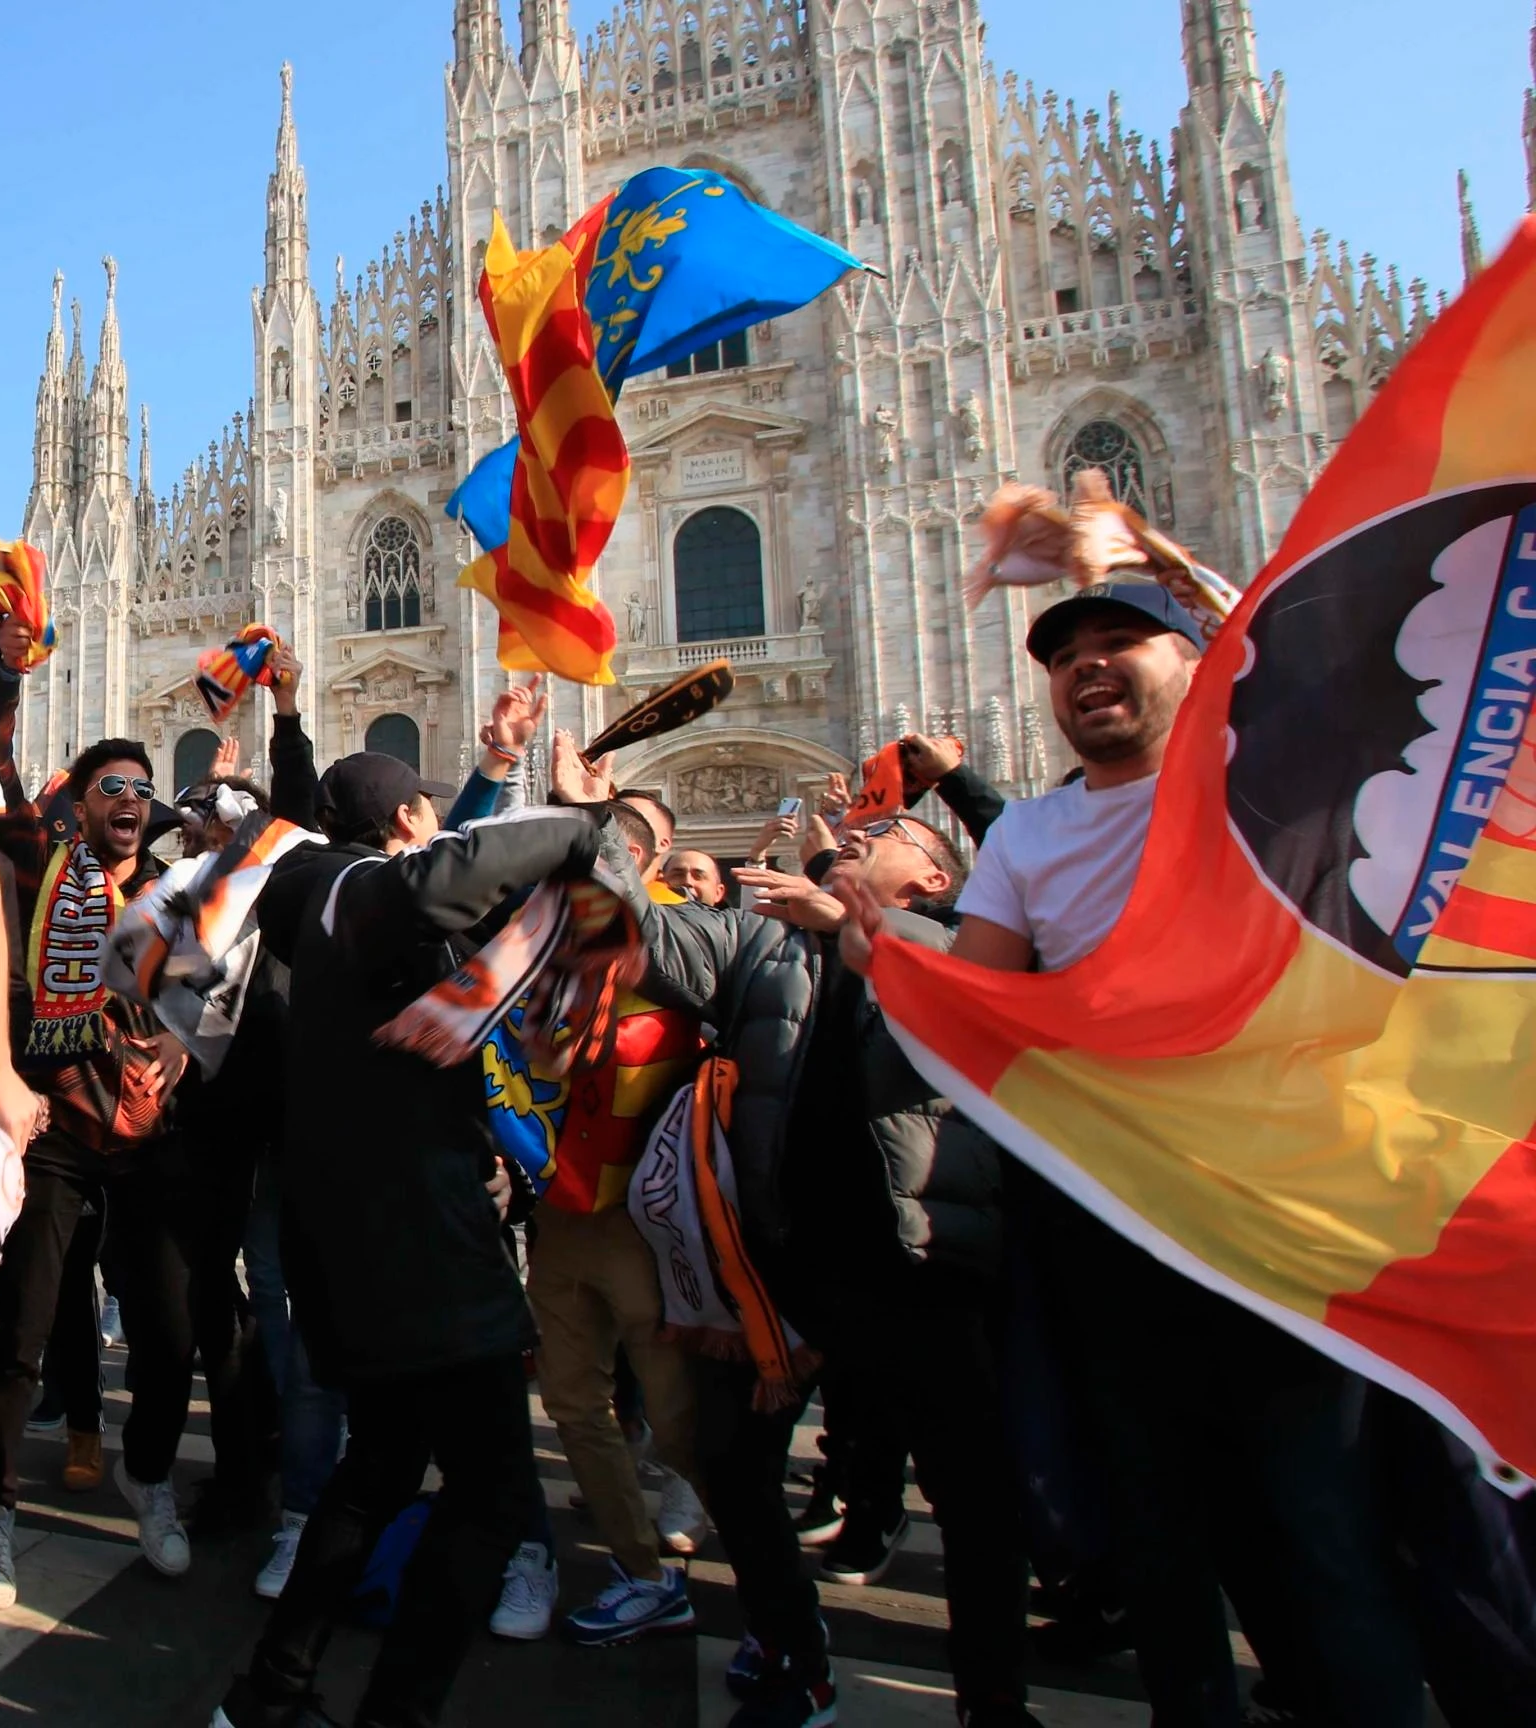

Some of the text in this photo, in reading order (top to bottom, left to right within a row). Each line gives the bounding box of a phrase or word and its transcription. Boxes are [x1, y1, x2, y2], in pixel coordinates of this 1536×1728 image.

[690, 455, 734, 467] MARIAE
[685, 467, 742, 481] NASCENTI
[1408, 648, 1536, 938] VALENCIA
